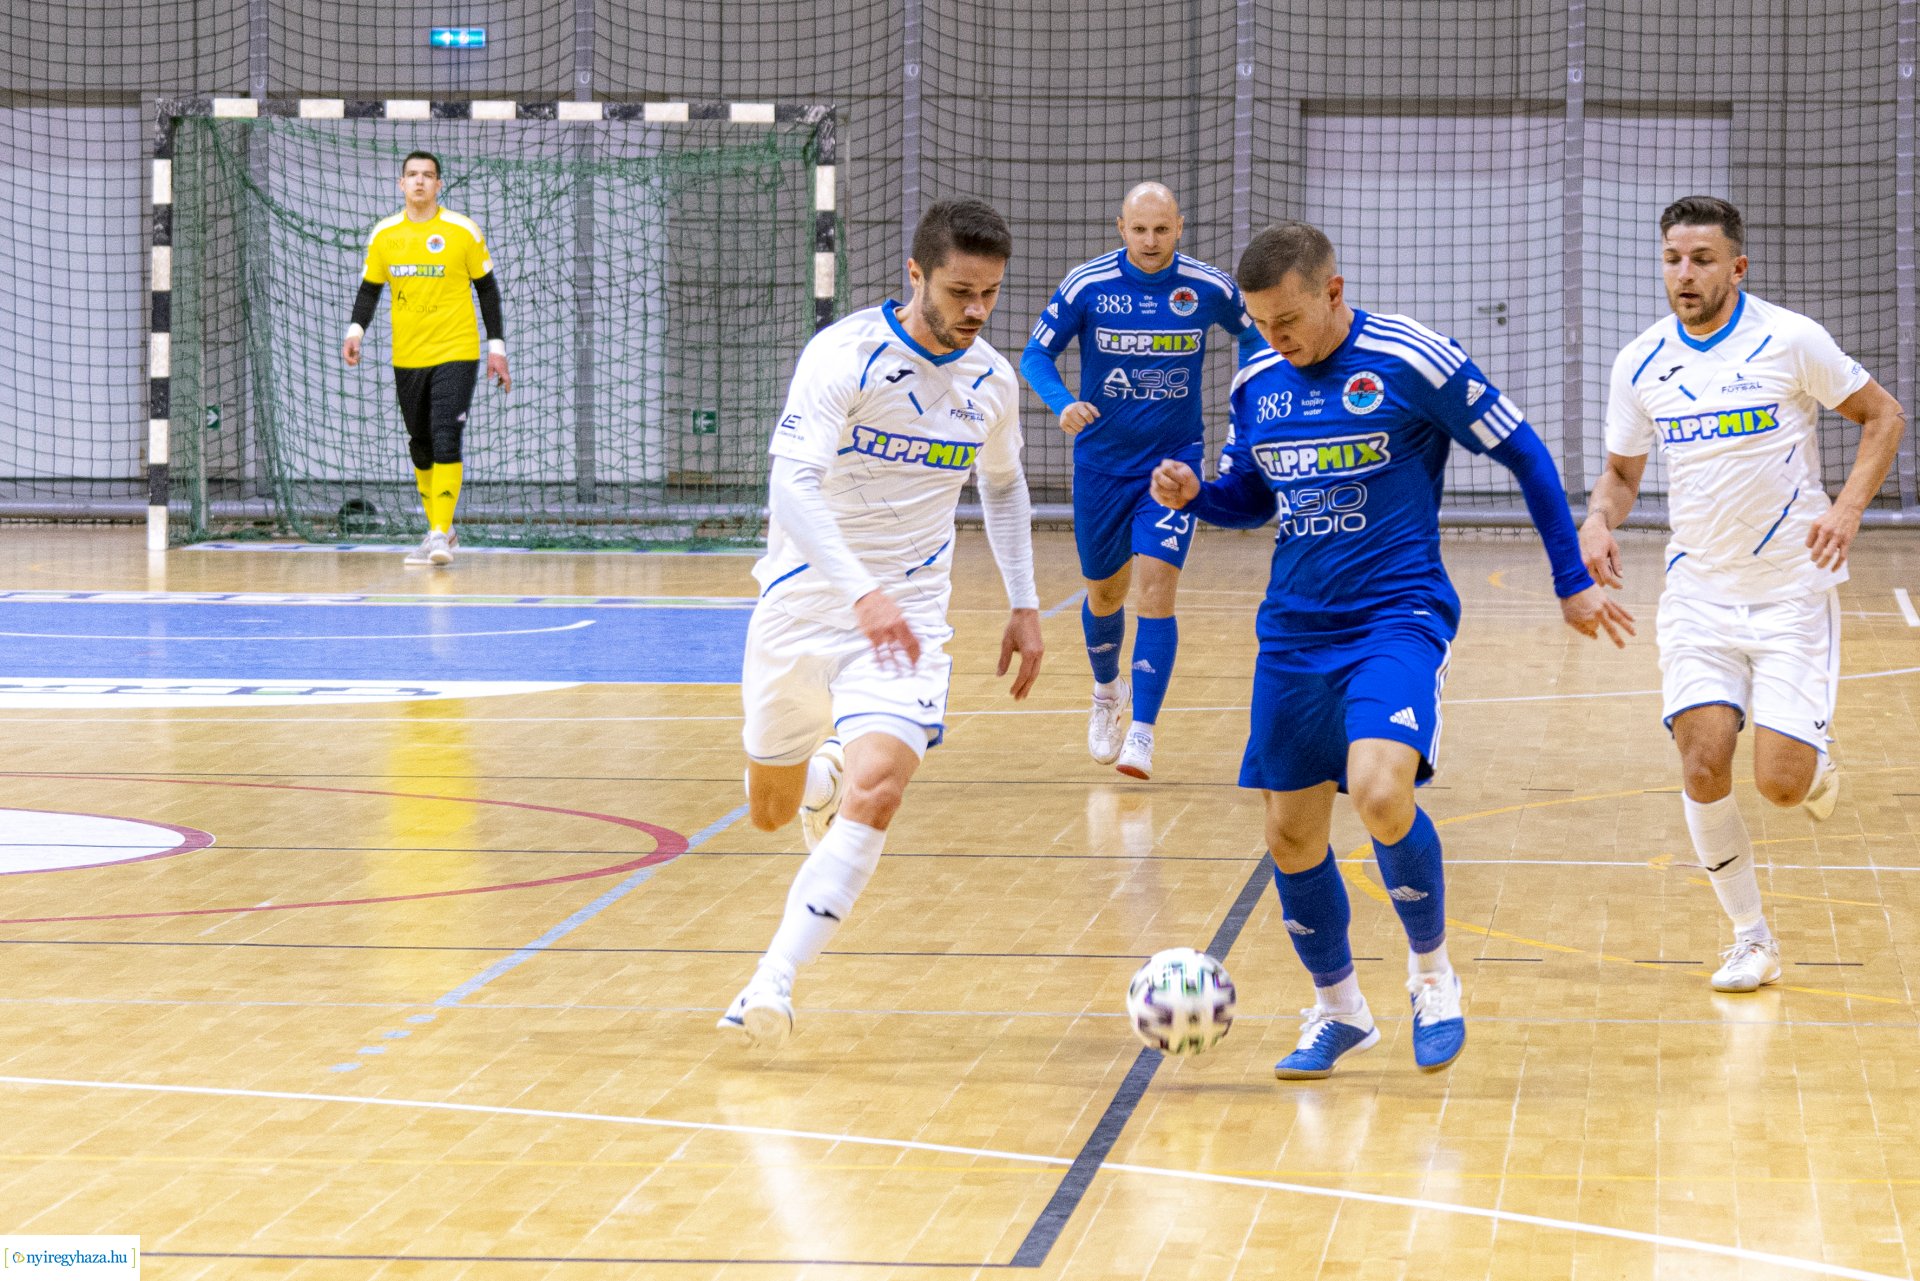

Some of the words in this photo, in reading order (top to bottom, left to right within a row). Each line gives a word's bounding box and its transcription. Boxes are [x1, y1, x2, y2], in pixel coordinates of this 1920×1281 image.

[1096, 294, 1132, 314] 383
[1103, 385, 1189, 400] STUDIO
[1309, 389, 1321, 397] the
[1256, 390, 1293, 424] 383
[1303, 408, 1322, 416] water
[1275, 513, 1367, 538] TUDIO
